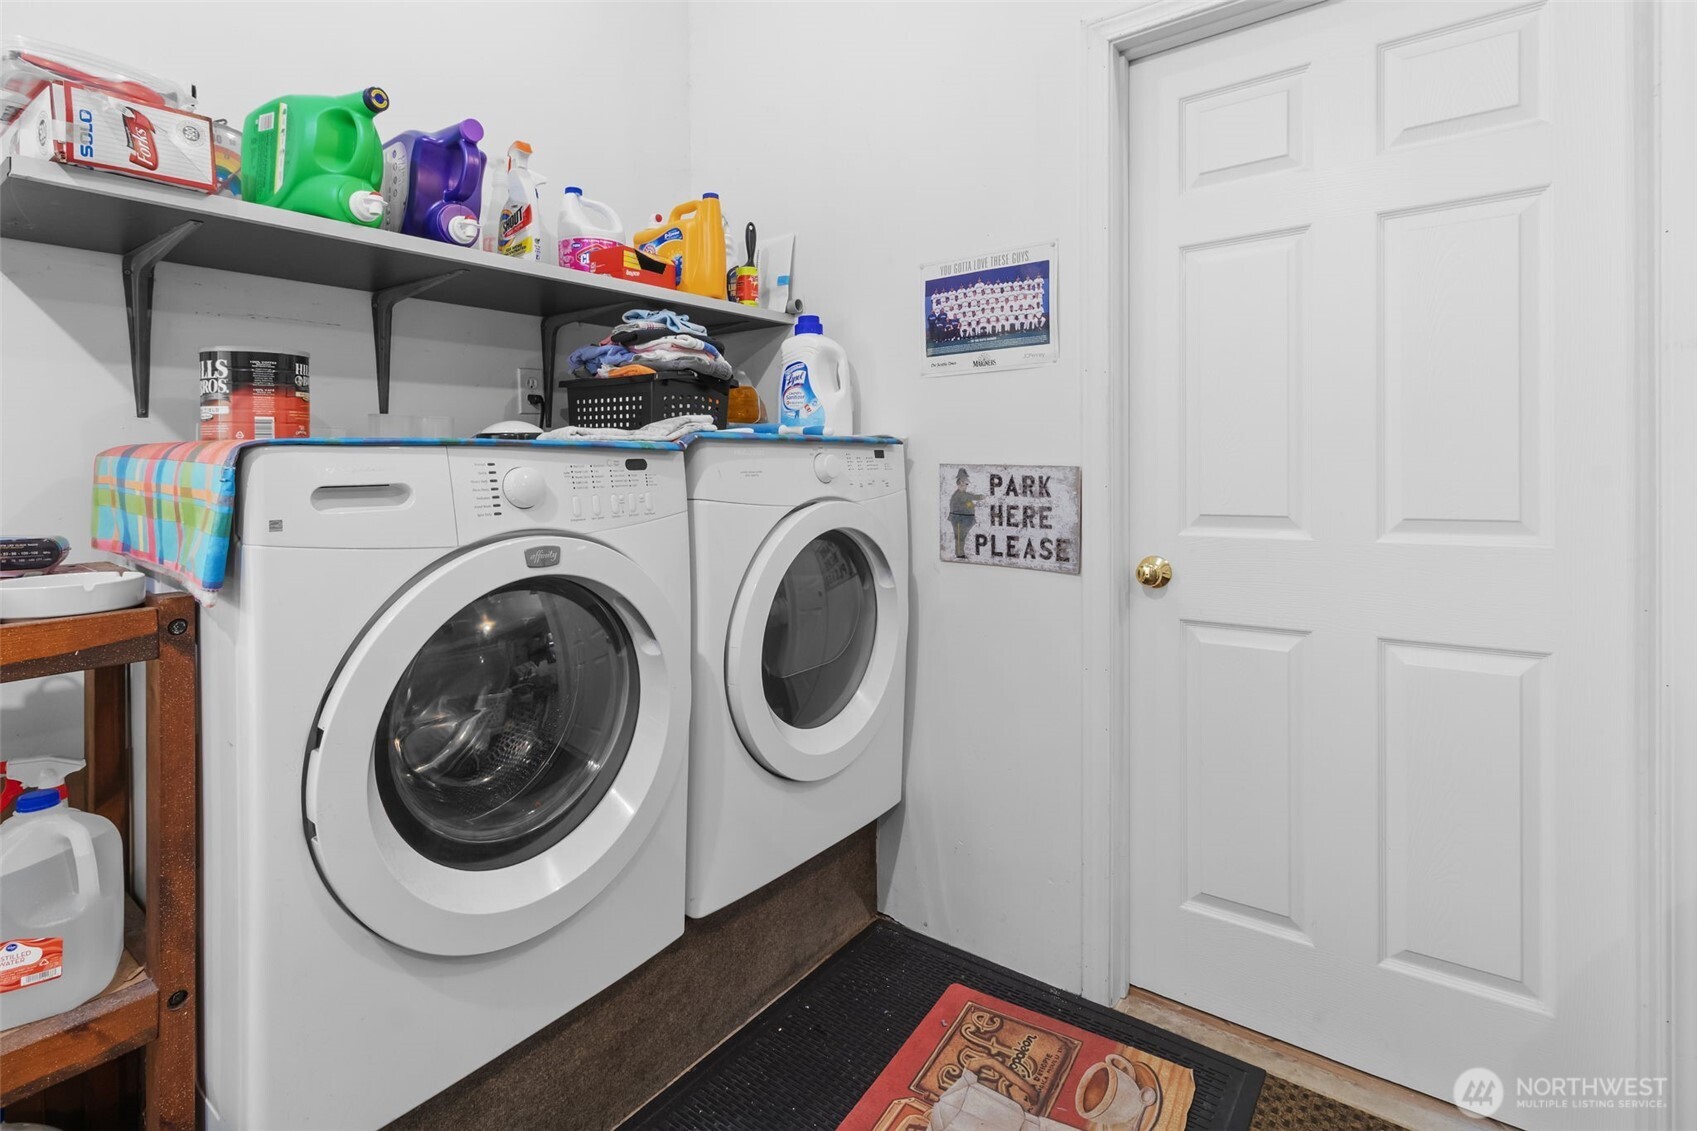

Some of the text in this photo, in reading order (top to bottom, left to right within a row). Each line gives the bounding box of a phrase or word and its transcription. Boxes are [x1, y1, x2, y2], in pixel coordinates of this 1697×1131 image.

[79, 109, 94, 158] SOLO
[135, 126, 154, 167] Forks
[940, 250, 1030, 276] YOU GOTTA LOVE THESE GUYS
[989, 474, 1051, 498] PARK
[990, 504, 1052, 530] HERE
[975, 533, 1071, 563] PLEASE
